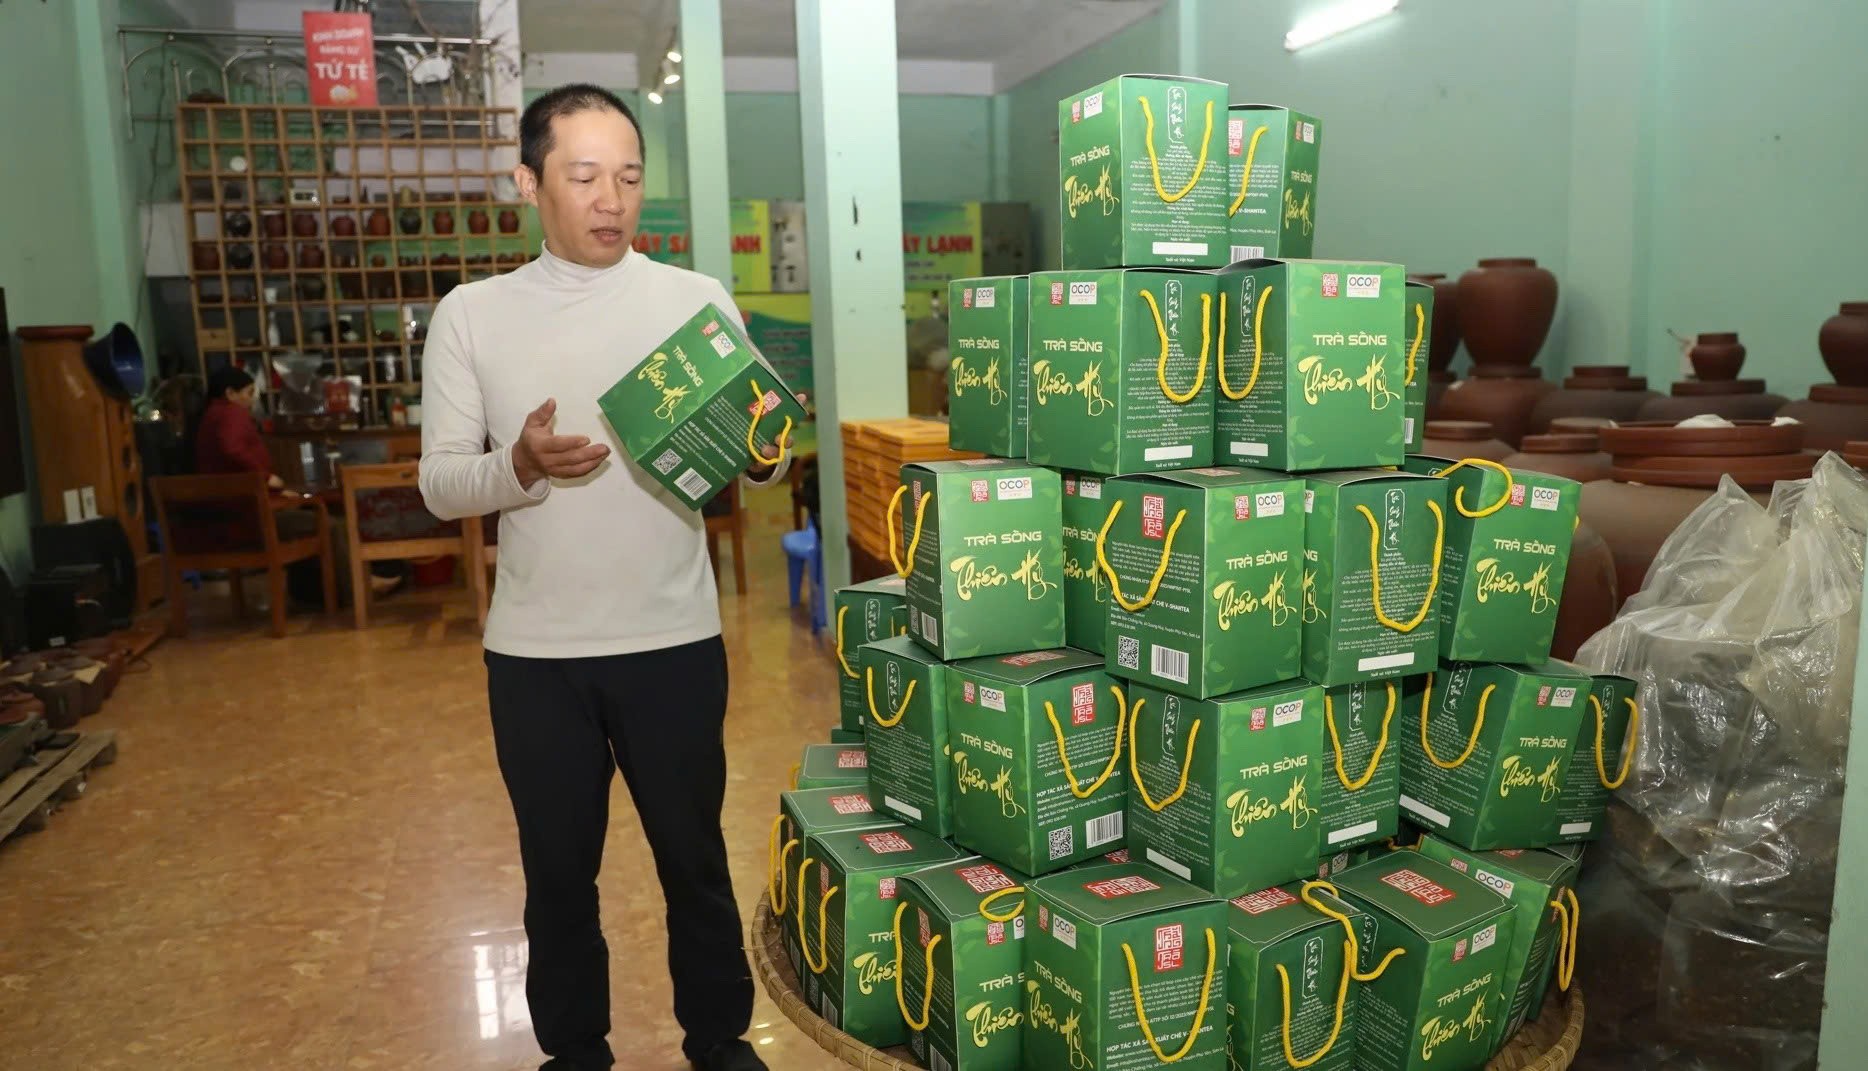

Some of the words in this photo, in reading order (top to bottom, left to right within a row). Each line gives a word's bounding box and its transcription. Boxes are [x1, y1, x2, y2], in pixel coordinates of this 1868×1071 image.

[1085, 93, 1102, 107] OCOP
[1070, 153, 1087, 167] TRÀ
[1071, 283, 1096, 294] OCOP
[1349, 276, 1378, 287] OCOP
[977, 290, 994, 299] OCOP
[958, 338, 975, 349] TRÀ
[1043, 338, 1067, 351] TRÀ
[1313, 332, 1345, 345] TRÀ
[1033, 360, 1073, 405] Thiên
[1298, 355, 1352, 405] Thiên
[999, 480, 1029, 490] OCOP
[1257, 494, 1283, 506] OCOP
[1534, 489, 1558, 500] OCOP
[964, 533, 997, 547] TRÀ
[1494, 537, 1520, 551] TRÀ
[1226, 556, 1252, 570] TRÀ
[950, 556, 1008, 601] Thiên
[1476, 558, 1520, 603] Thiên
[1213, 581, 1258, 631] Thiên
[981, 688, 1004, 700] OCOP
[1555, 689, 1574, 699] OCOP
[1275, 702, 1302, 716] OCOP
[960, 732, 981, 746] TRÀ
[1520, 736, 1539, 747] TRÀ
[1240, 763, 1270, 780] TRÀ
[1227, 789, 1277, 837] Thiên
[1477, 872, 1512, 891] OCOP
[1054, 916, 1076, 935] OCOP
[1474, 927, 1496, 944] OCOP
[1034, 961, 1052, 983] TRÀ
[1437, 990, 1462, 1008] TRÀ
